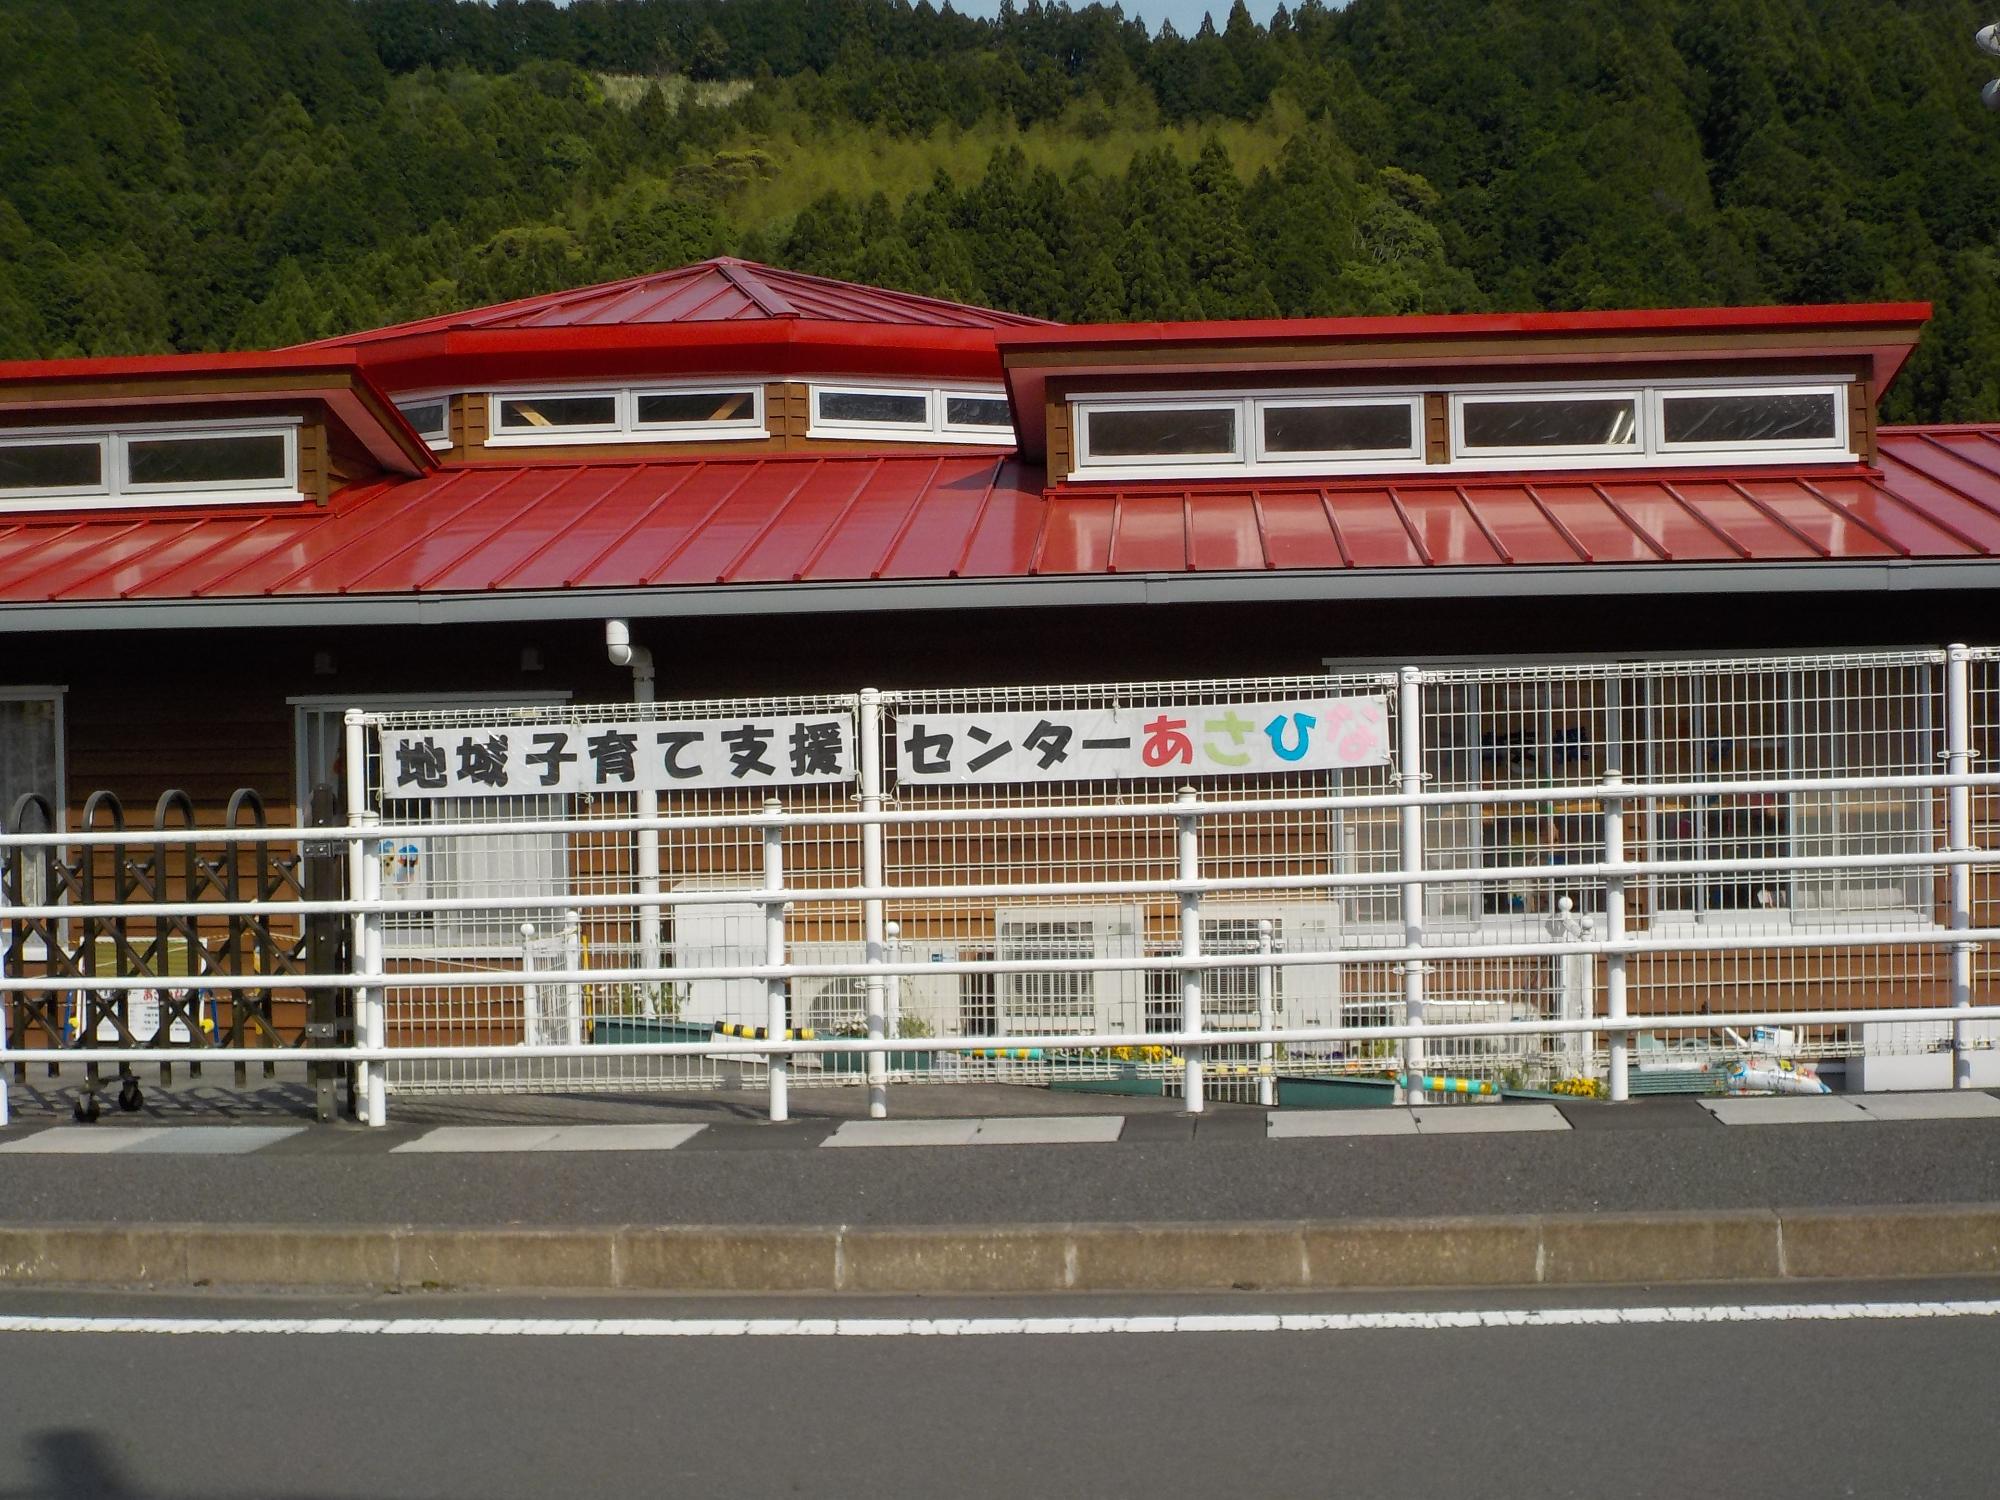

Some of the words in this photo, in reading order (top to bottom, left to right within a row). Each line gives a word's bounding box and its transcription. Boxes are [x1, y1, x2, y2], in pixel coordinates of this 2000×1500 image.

[396, 722, 843, 789] 地域子育て支援
